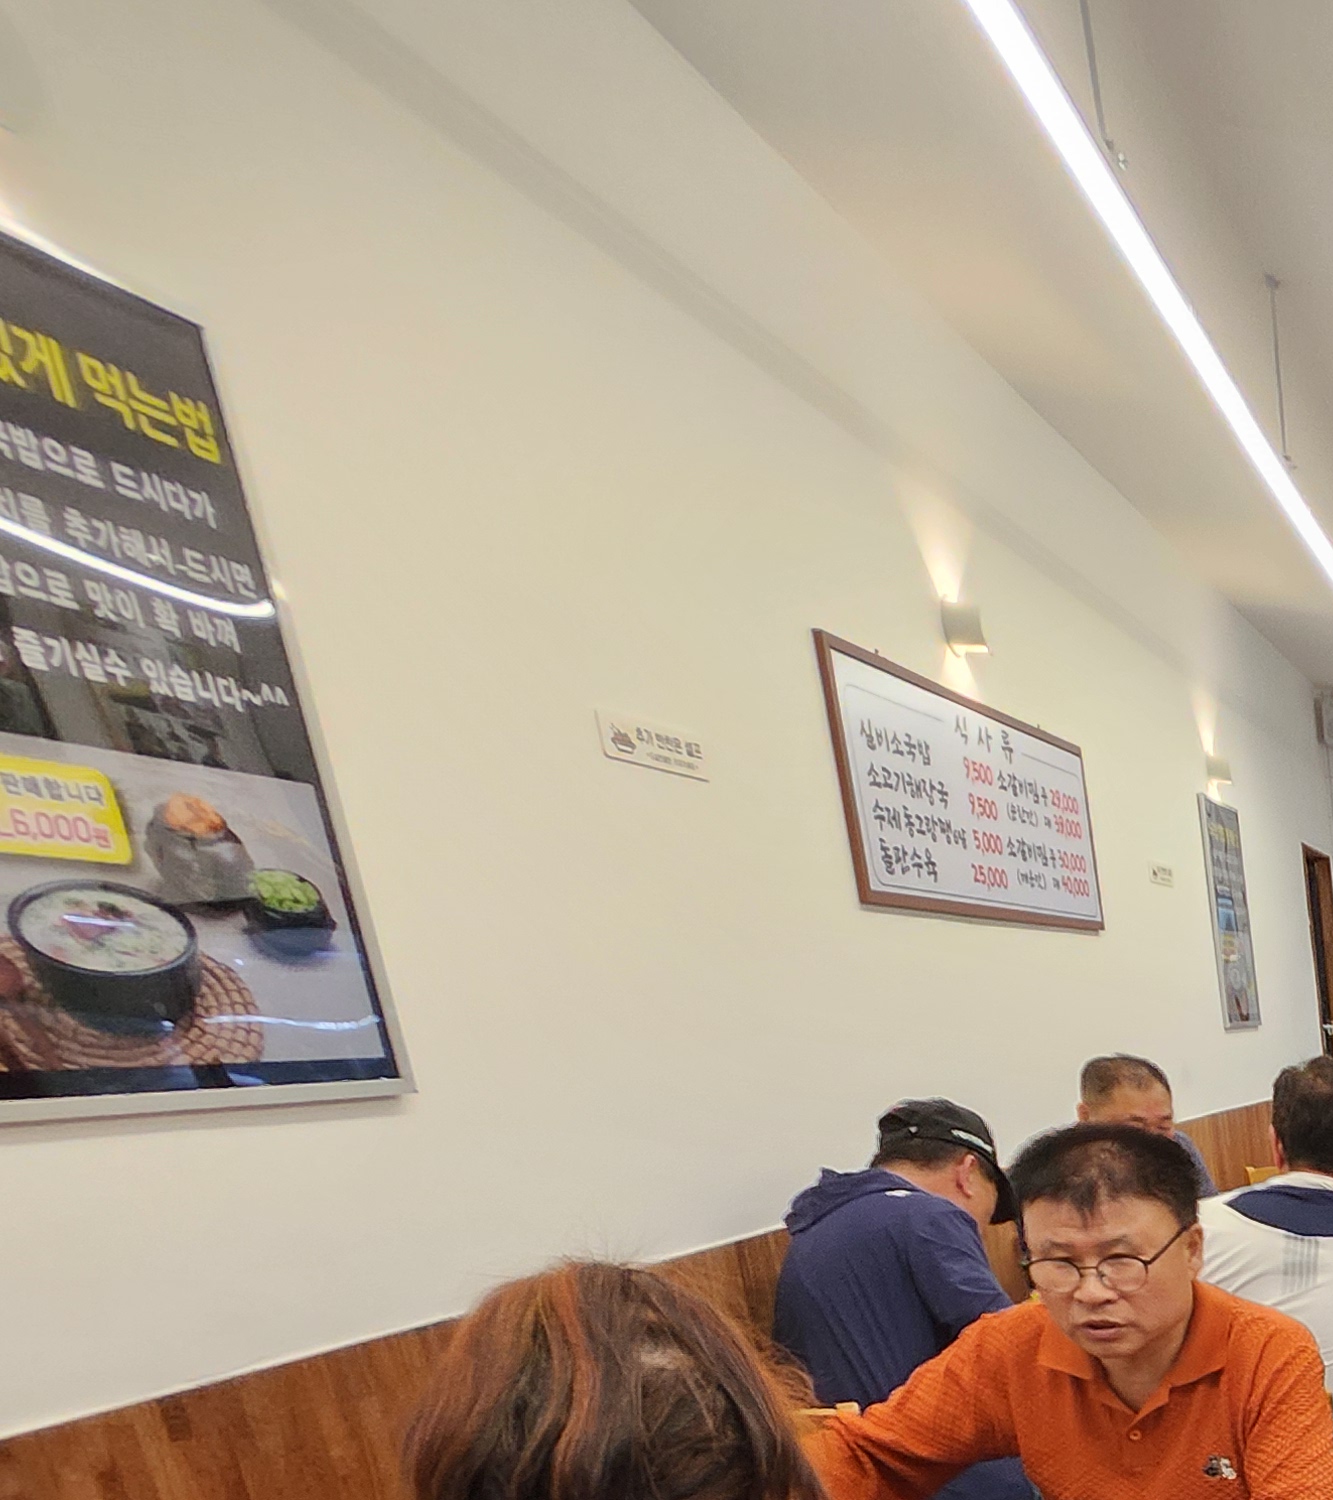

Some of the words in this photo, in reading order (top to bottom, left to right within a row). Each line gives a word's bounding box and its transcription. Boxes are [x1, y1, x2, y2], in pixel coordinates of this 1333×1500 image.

[77, 352, 221, 464] 먹는법
[110, 461, 217, 529] 드시다가
[63, 505, 176, 576] 추가해서
[183, 547, 258, 599] 드시면
[83, 579, 146, 629] 맛이
[154, 597, 182, 639] 확
[187, 609, 241, 653] 바껴
[11, 626, 133, 687] 즐기실수
[860, 719, 931, 766] 실비소국밥
[963, 756, 994, 787] 9,500
[867, 762, 949, 809] 소고기해장국
[968, 793, 999, 821] 9,500
[872, 798, 902, 832] 수제
[972, 829, 1004, 857] 5,000
[971, 863, 1009, 891] 25,000
